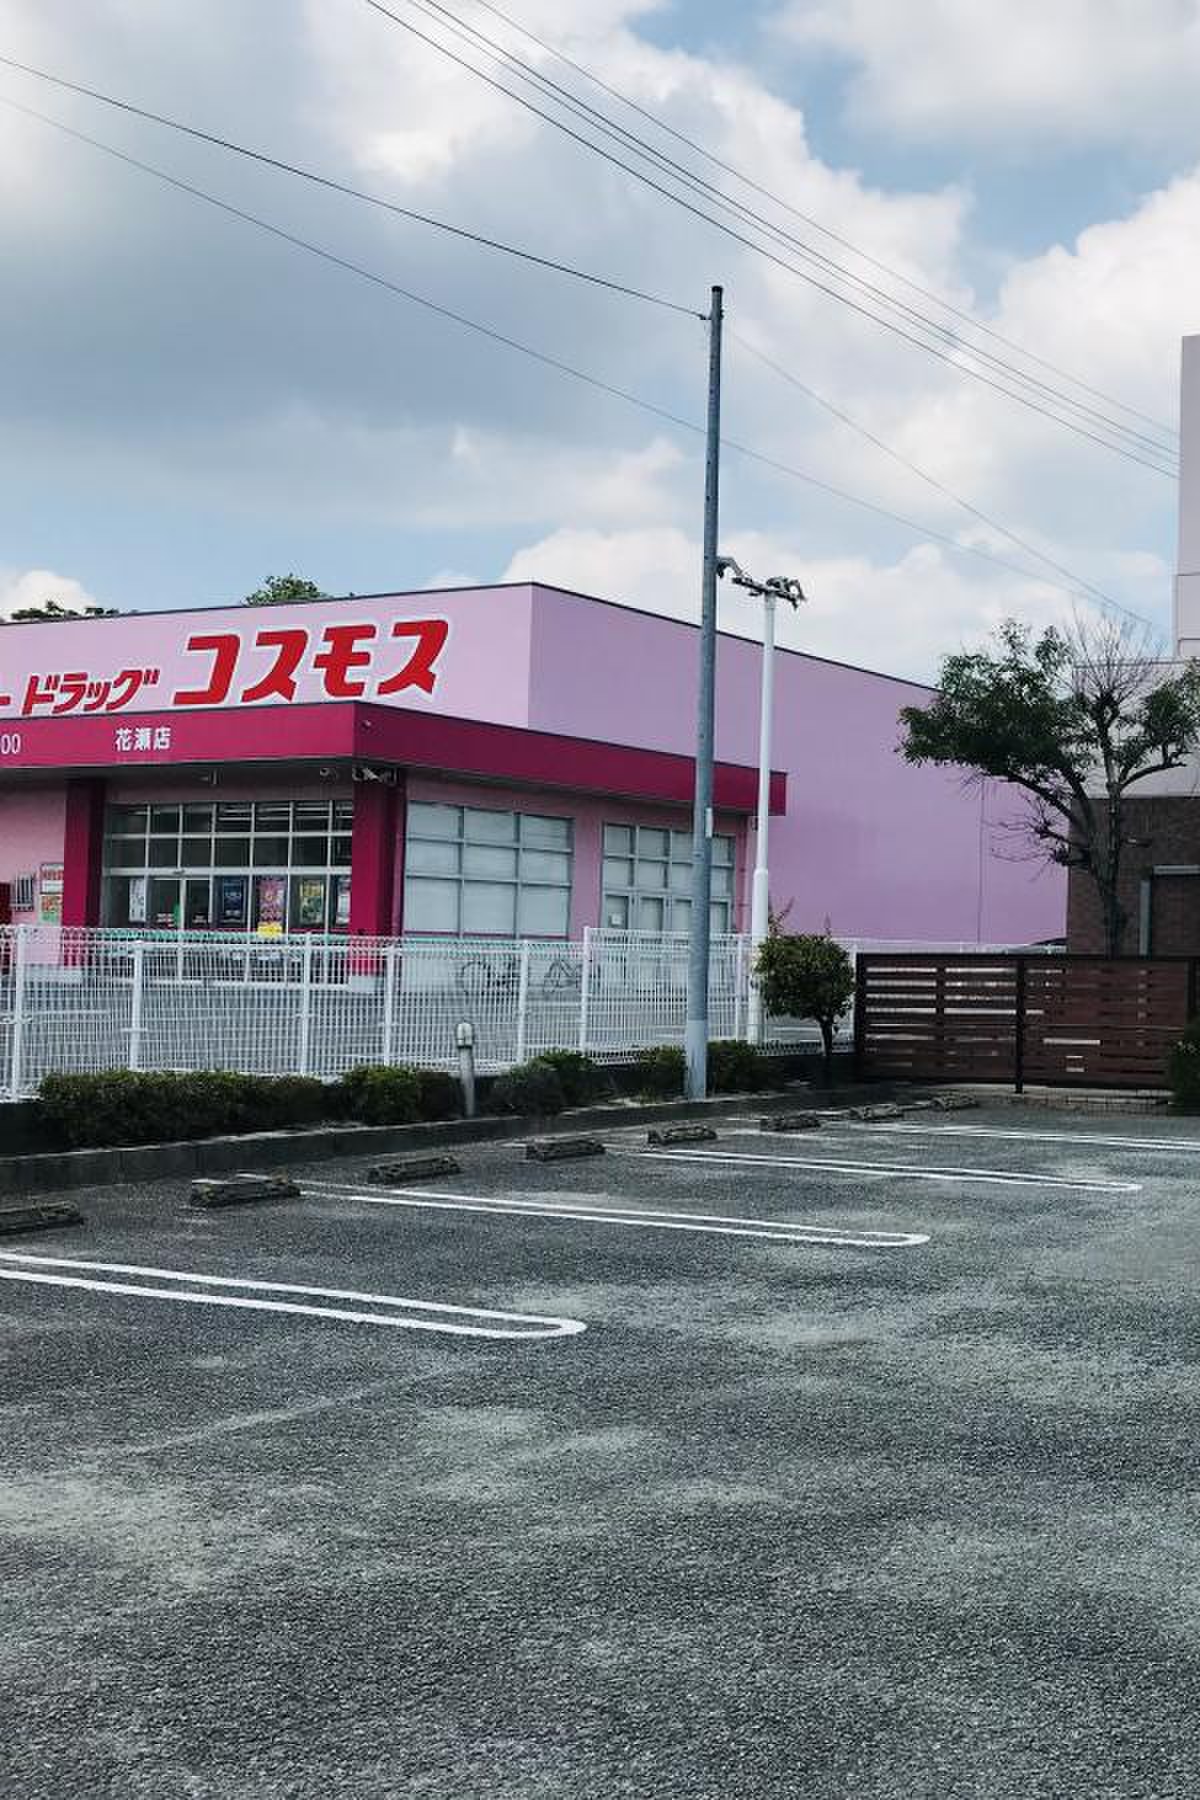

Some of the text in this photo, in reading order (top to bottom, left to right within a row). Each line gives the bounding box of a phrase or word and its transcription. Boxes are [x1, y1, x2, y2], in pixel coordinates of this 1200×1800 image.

[173, 619, 449, 705] コスモス
[115, 727, 171, 751] 花瀬店
